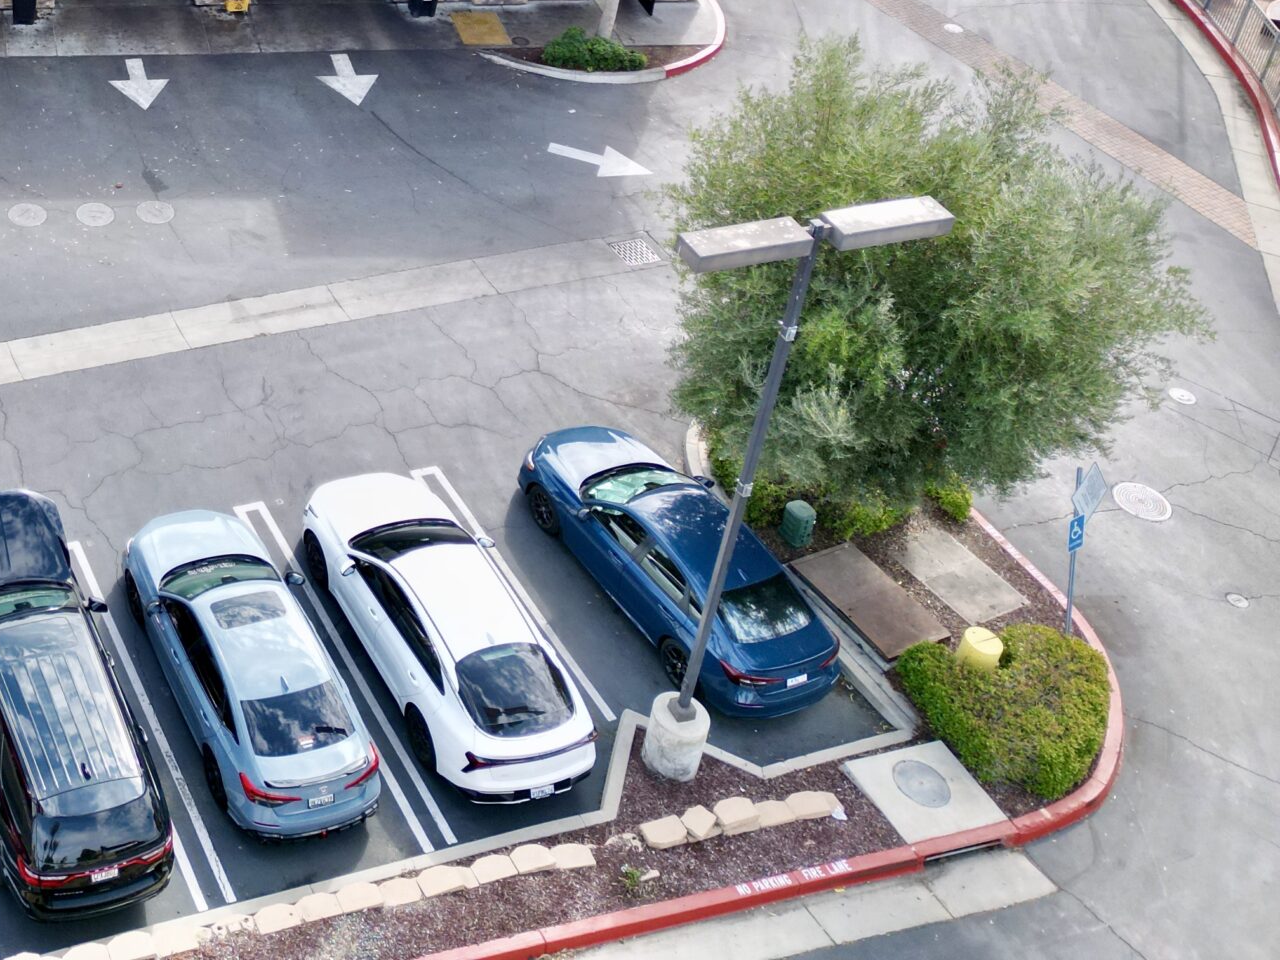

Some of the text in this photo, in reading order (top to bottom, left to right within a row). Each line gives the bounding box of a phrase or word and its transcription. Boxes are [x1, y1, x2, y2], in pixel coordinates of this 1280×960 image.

[735, 859, 853, 896] NO PARKING FIRE LANE
